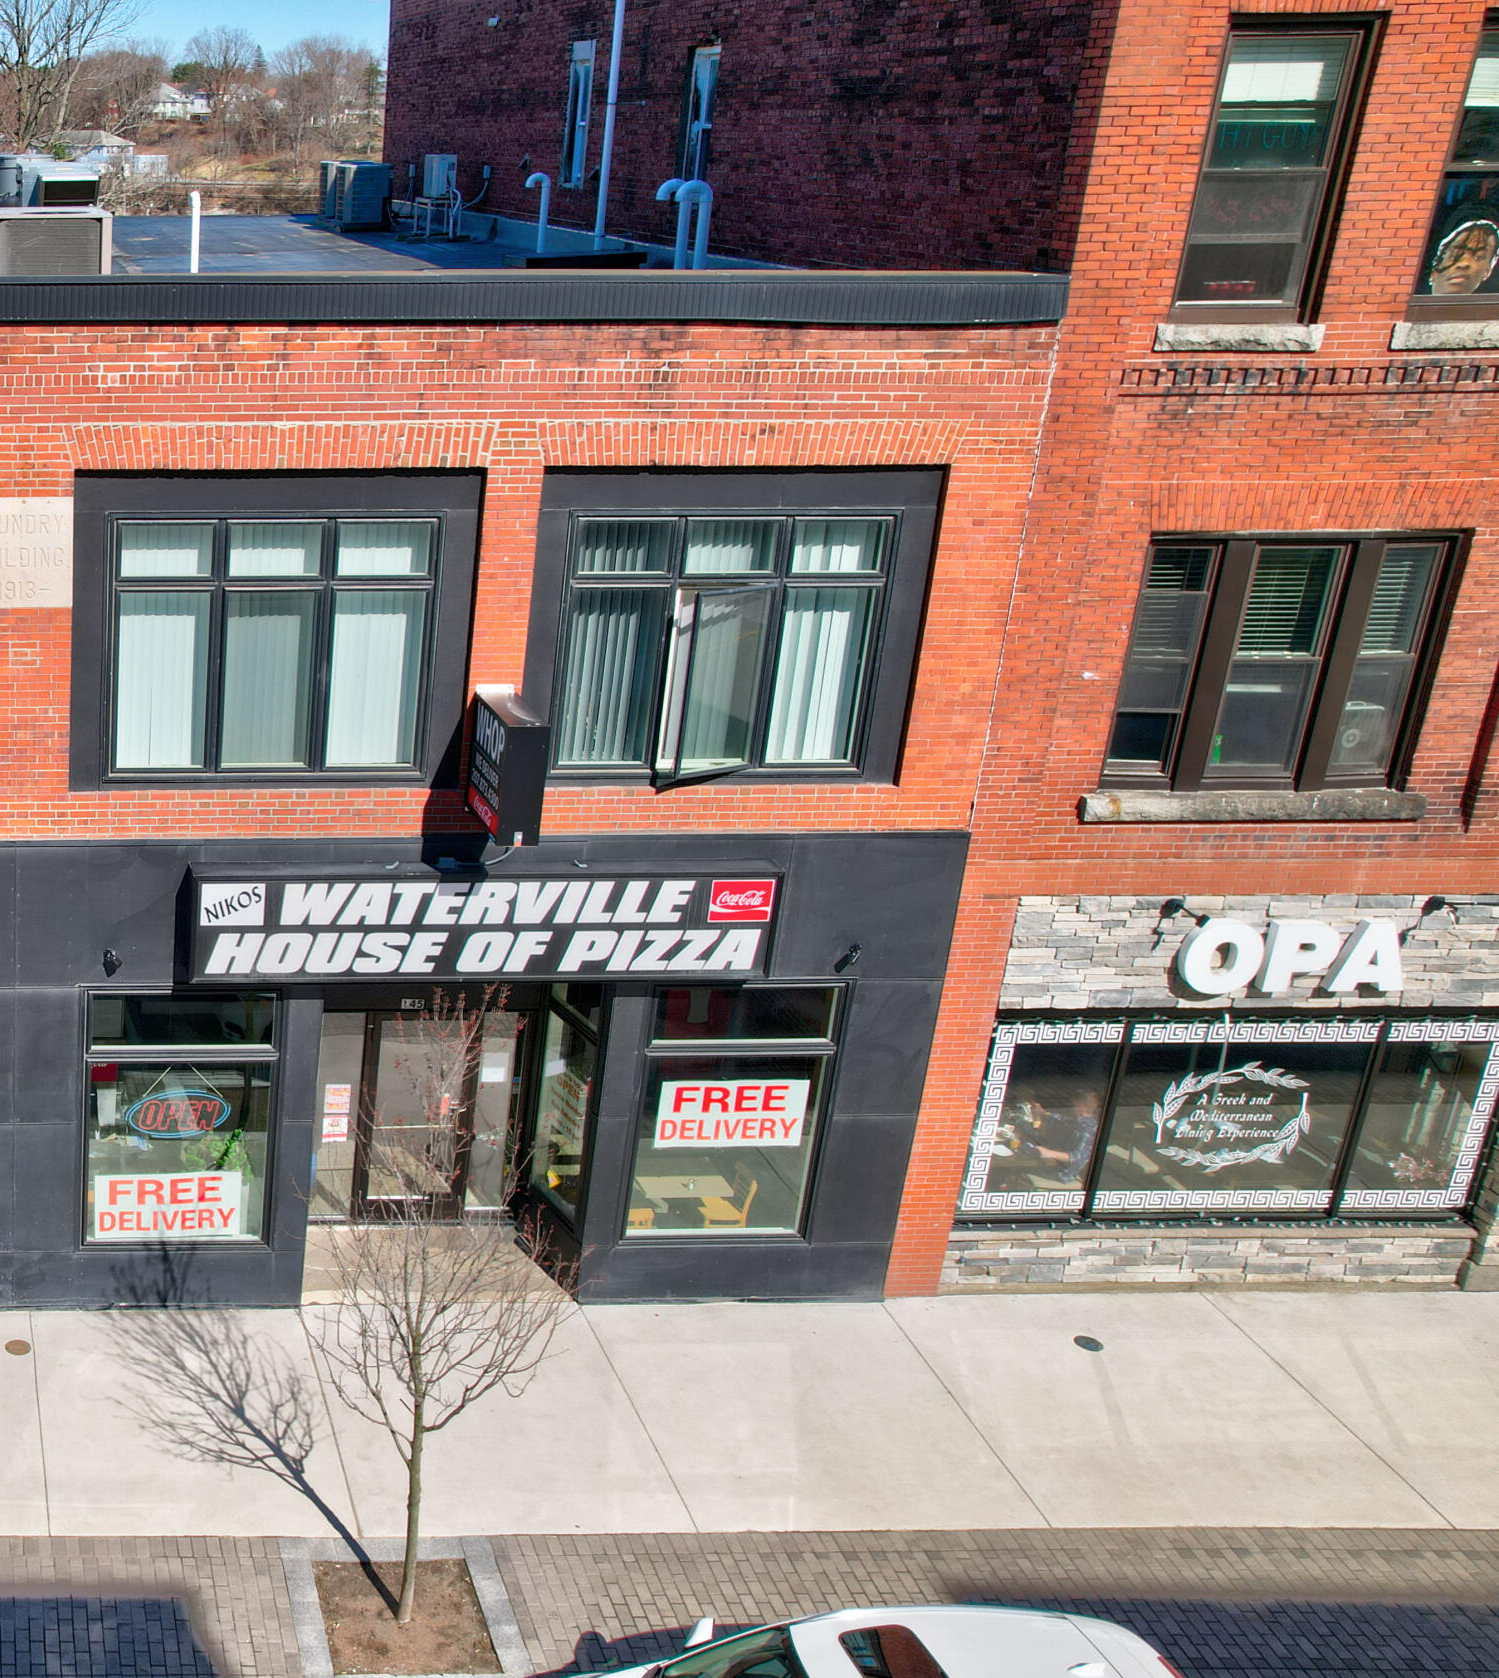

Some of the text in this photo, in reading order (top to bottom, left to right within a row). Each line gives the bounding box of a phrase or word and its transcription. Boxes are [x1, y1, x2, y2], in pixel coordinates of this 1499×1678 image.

[476, 702, 506, 766] WHOP
[203, 885, 263, 923] NIKOS
[279, 880, 697, 926] WATERVILLE
[203, 928, 762, 975] HOUSE OF PIZZA
[1176, 917, 1404, 995] OPA
[672, 1085, 790, 1113] FREE
[1196, 1092, 1275, 1106] A Greek and
[138, 1099, 221, 1131] OPEN
[658, 1117, 799, 1141] DELIVERY
[1216, 1127, 1280, 1143] Experience
[107, 1176, 223, 1206] FREE
[98, 1207, 237, 1233] DELIVERY
